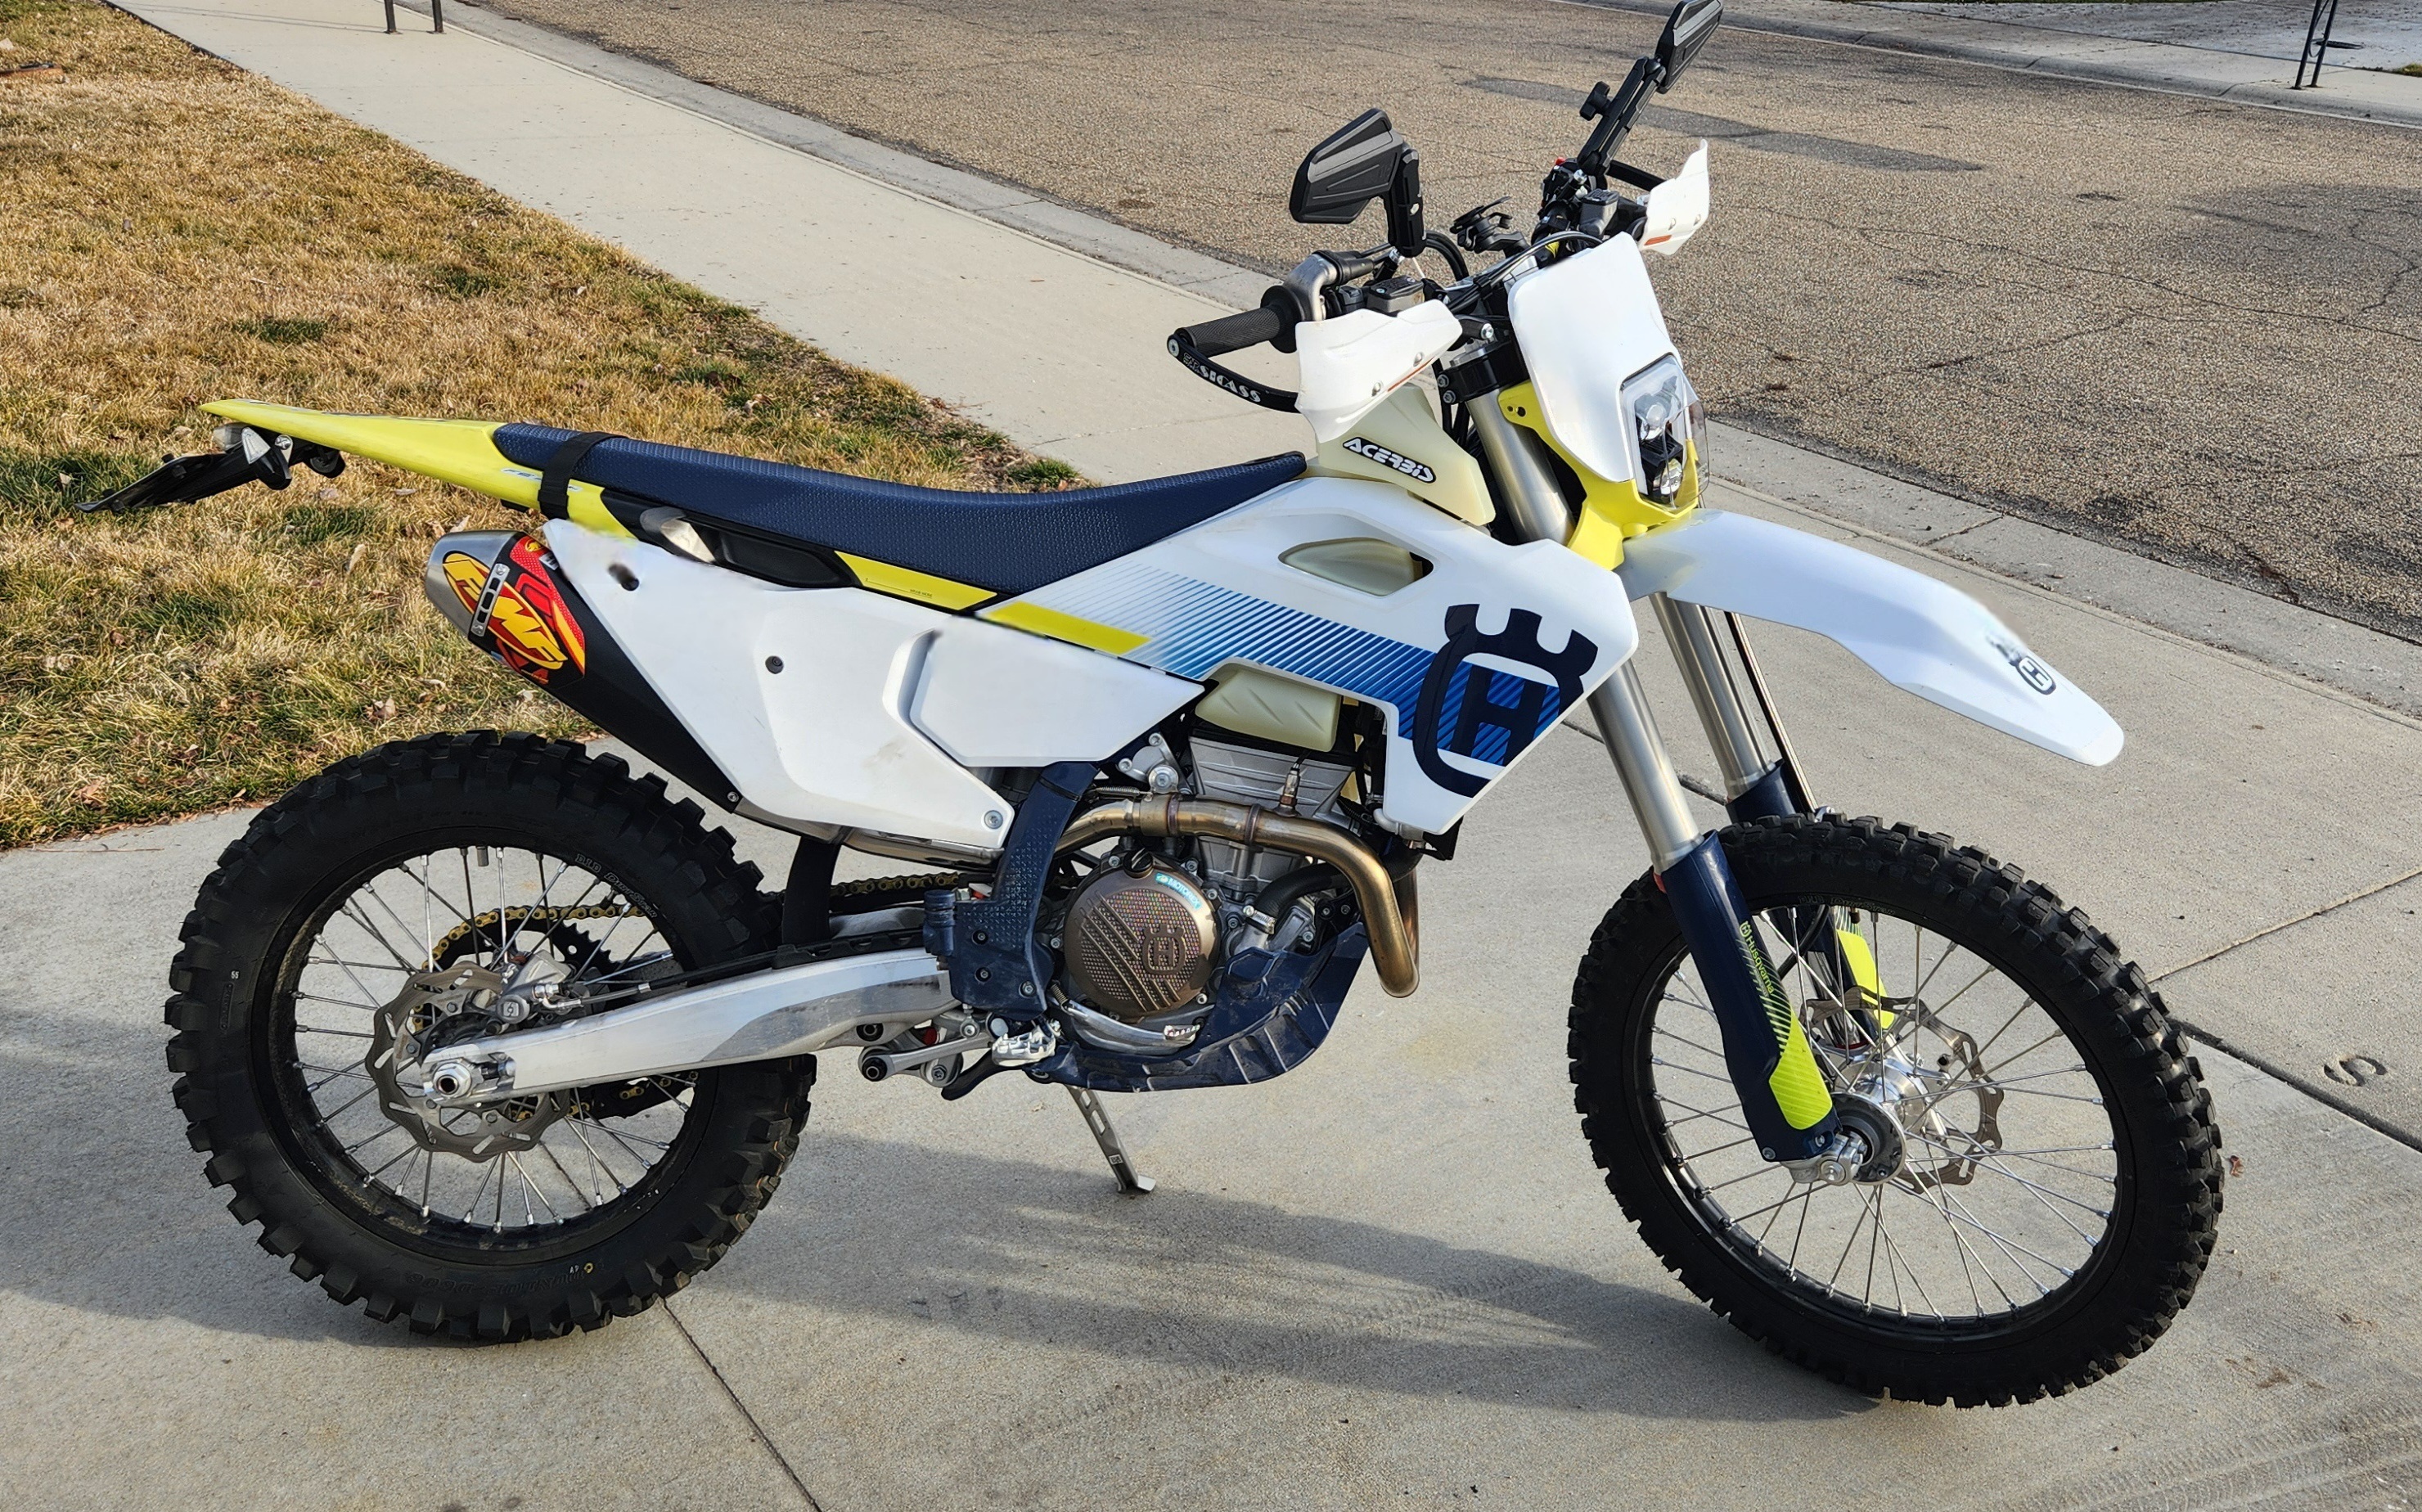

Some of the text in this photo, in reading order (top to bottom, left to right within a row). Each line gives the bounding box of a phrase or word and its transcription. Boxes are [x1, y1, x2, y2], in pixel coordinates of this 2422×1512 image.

[1199, 365, 1263, 403] SICASS
[1343, 438, 1434, 482] ACERBIS
[443, 560, 569, 662] FMF
[1167, 877, 1200, 909] MOTOREX
[1746, 937, 1775, 996] Husqvarna
